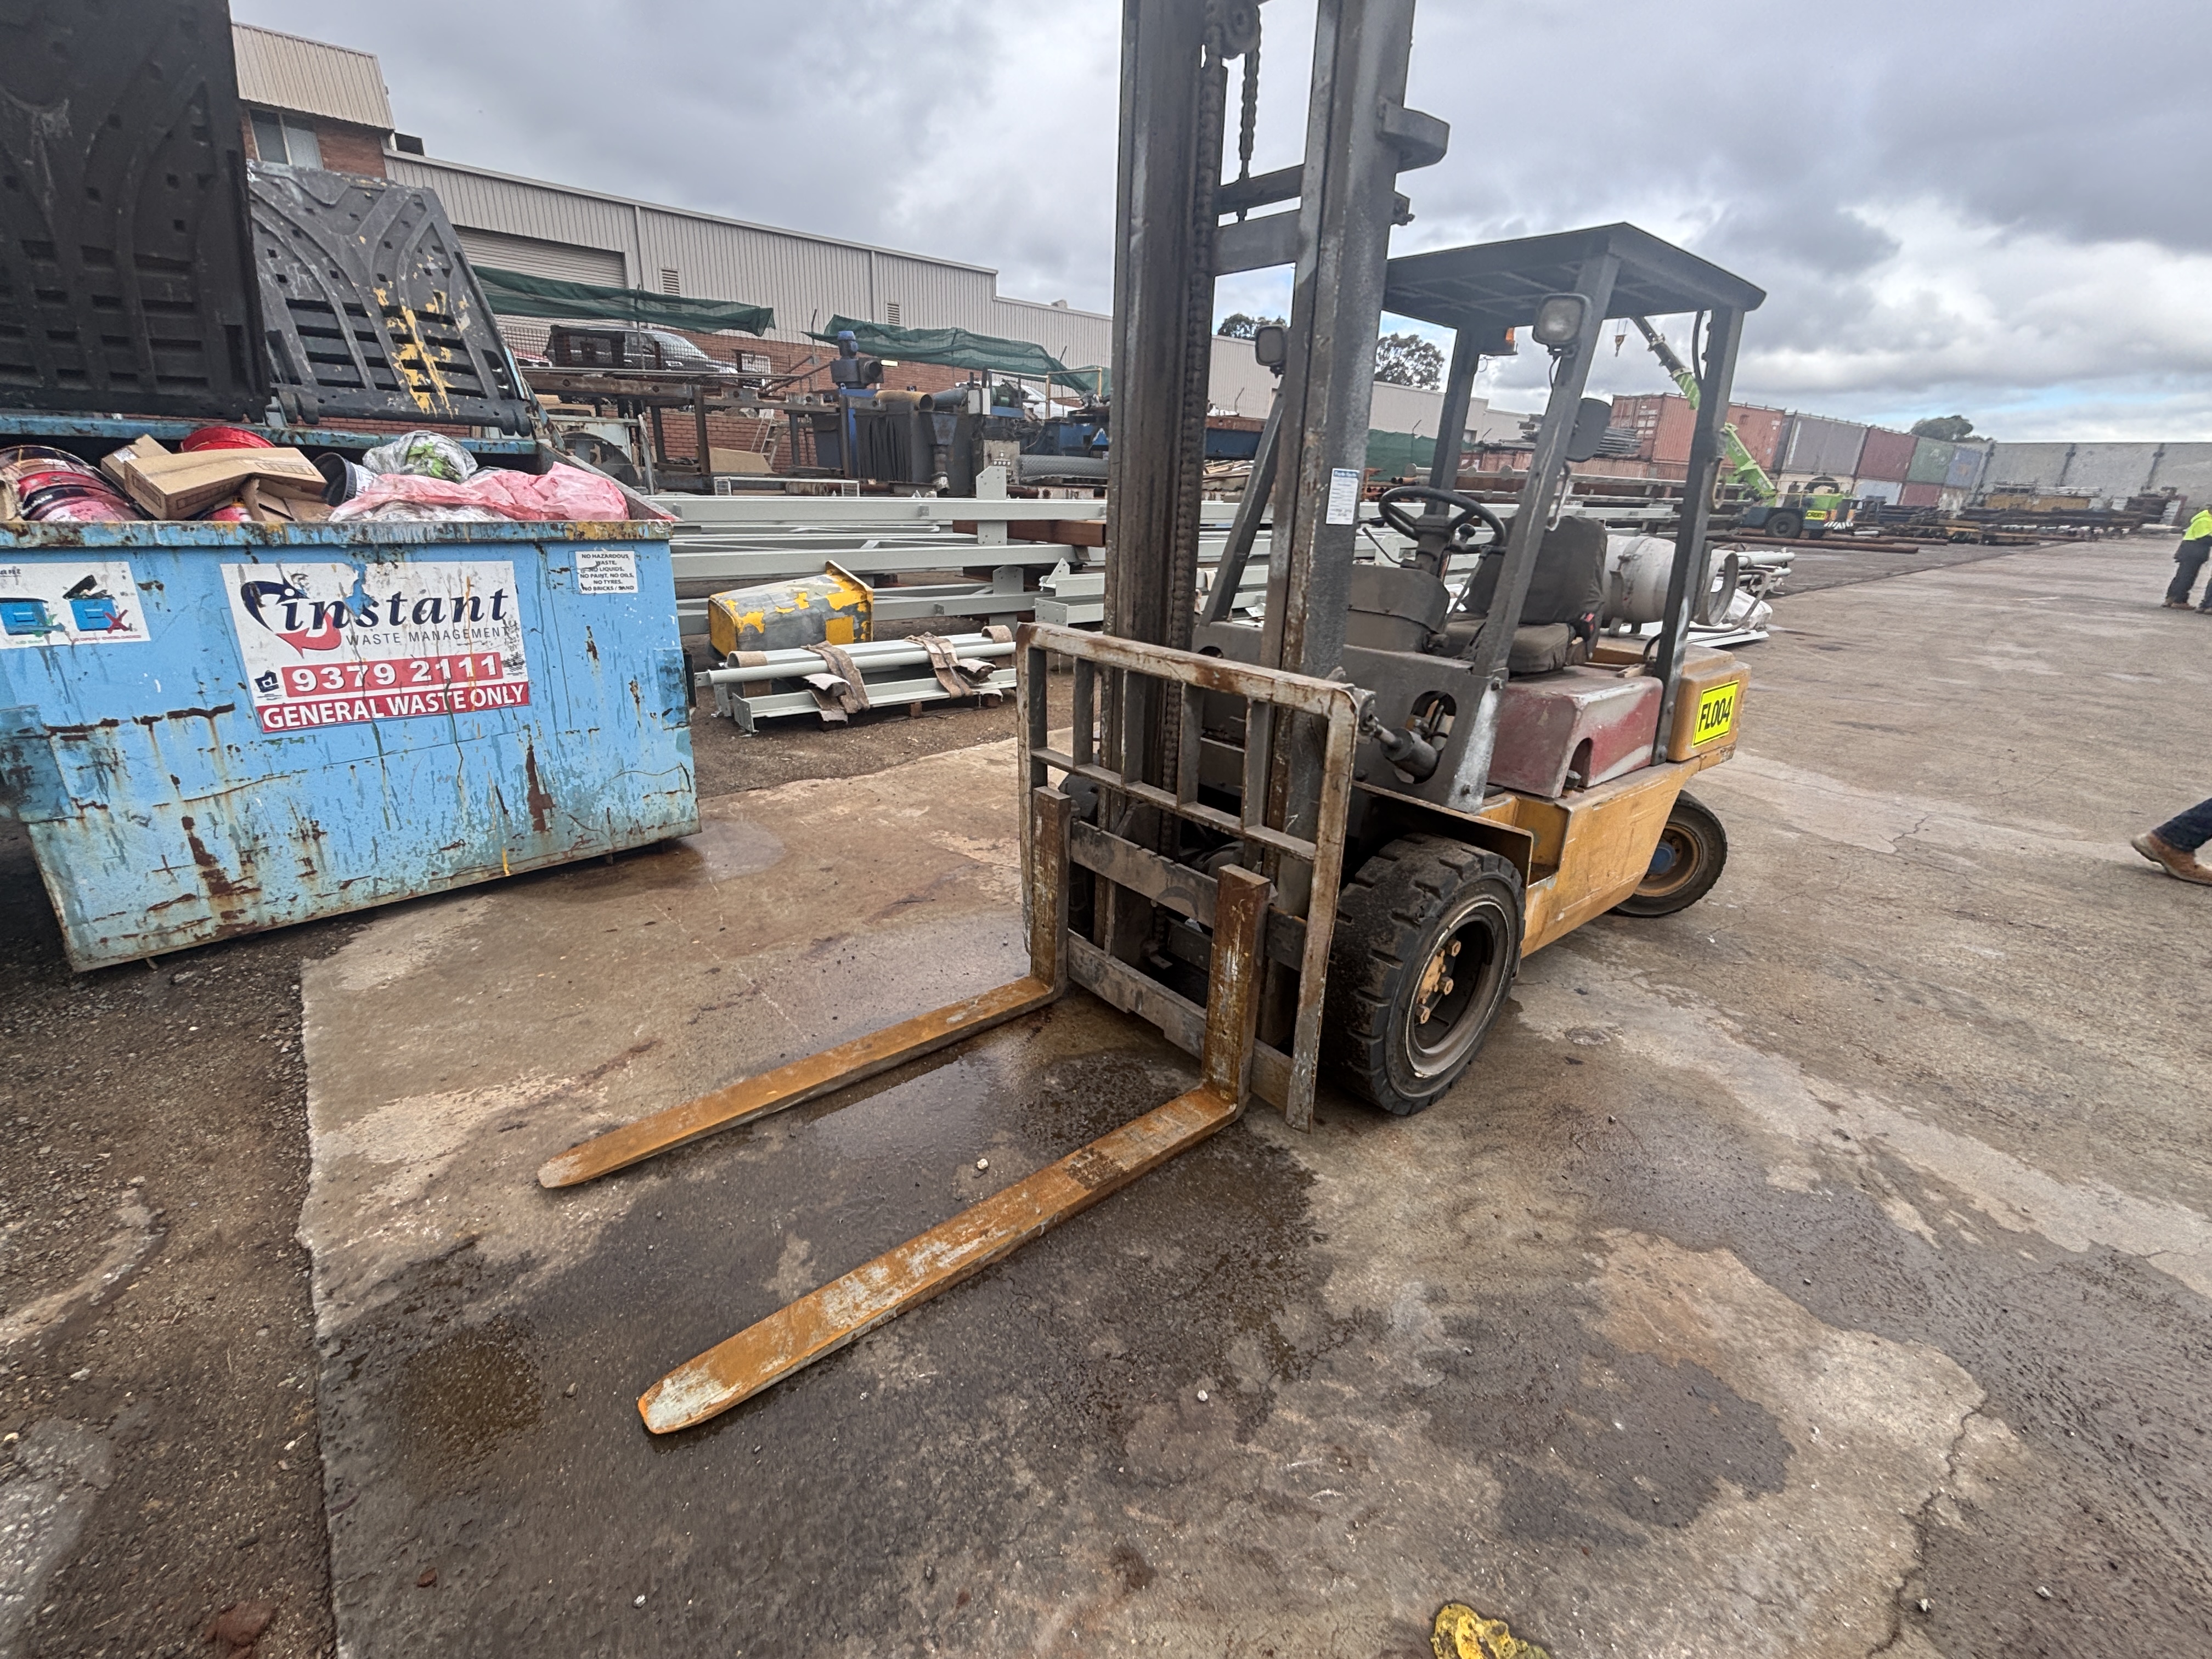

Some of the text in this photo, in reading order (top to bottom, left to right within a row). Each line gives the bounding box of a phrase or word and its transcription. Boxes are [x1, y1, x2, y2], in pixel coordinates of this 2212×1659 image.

[281, 589, 508, 631] instant
[346, 627, 509, 646] WASTE MANAGEMENT
[292, 655, 496, 692] 9379 2111
[263, 684, 524, 729] GENERAL WASTE ONLY
[1698, 696, 1733, 732] FL004
